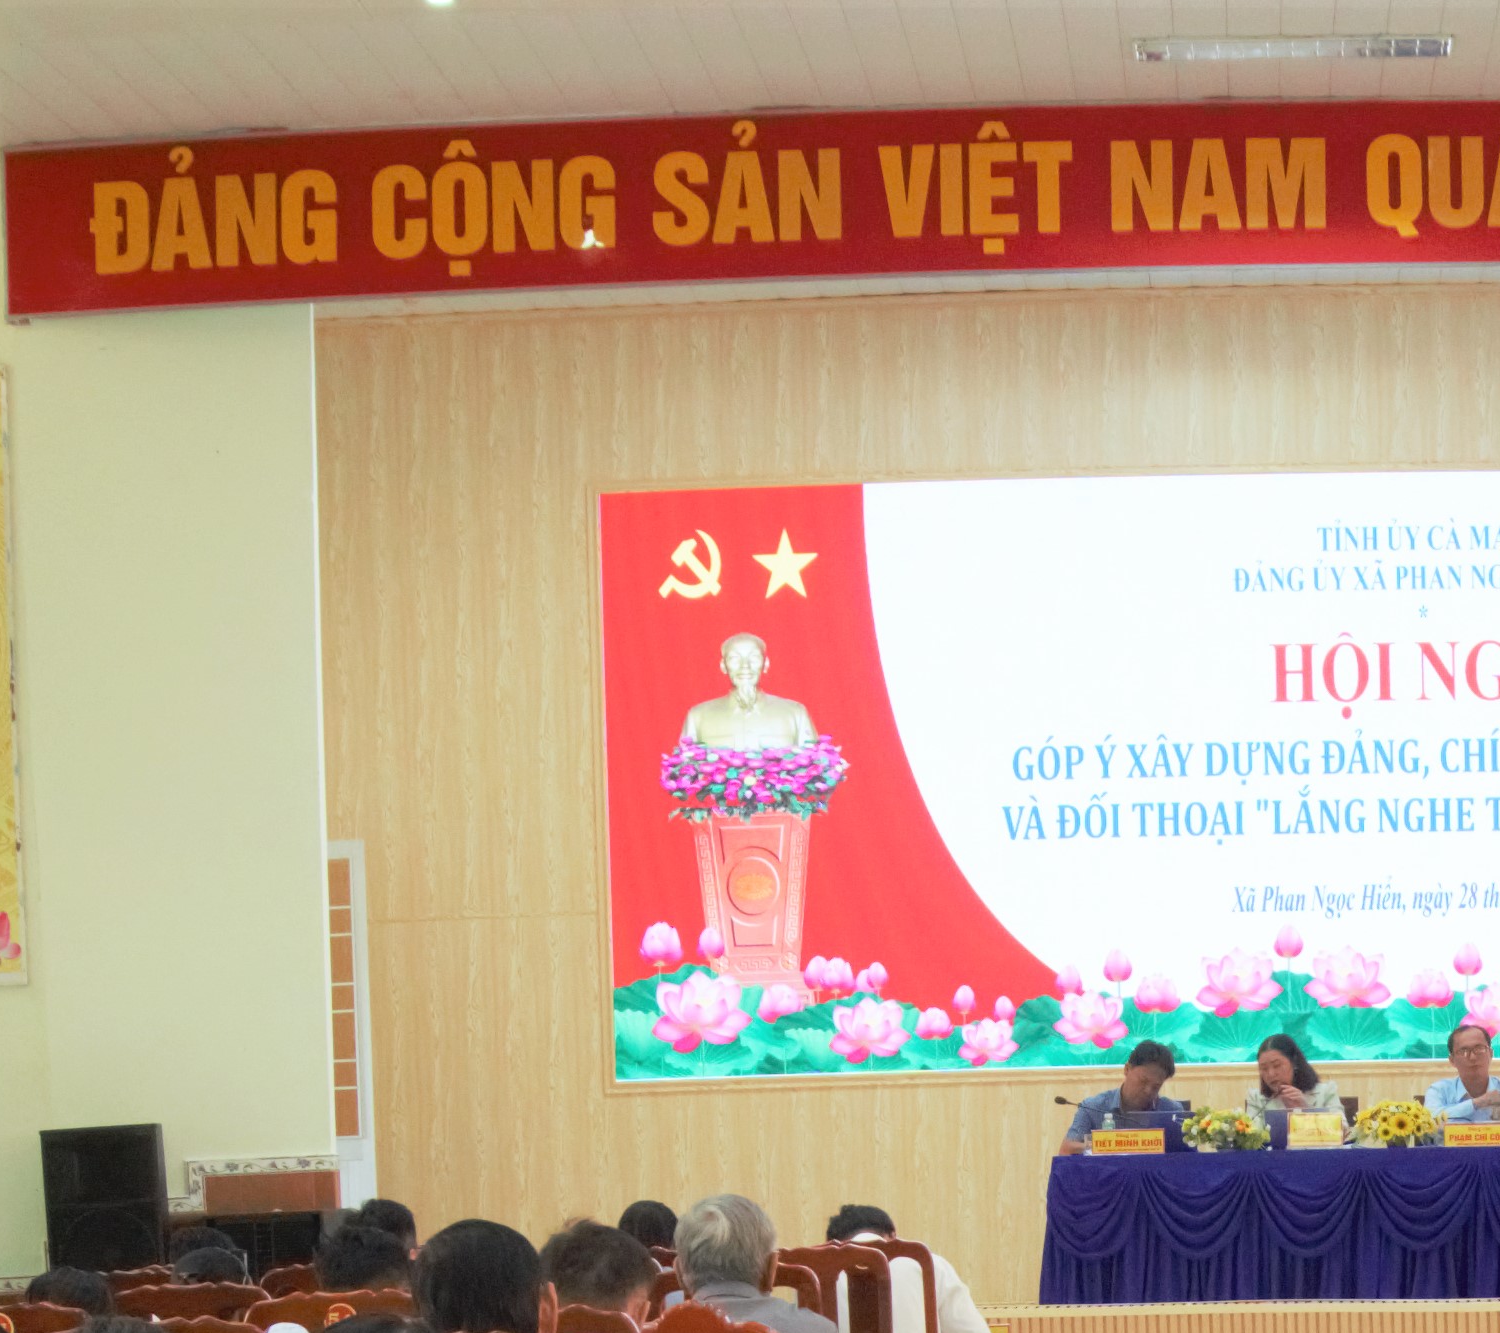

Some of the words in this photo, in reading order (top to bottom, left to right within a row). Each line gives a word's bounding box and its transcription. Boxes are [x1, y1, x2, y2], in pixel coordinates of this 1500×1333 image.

[90, 147, 337, 275] ĐẢNG
[372, 140, 616, 276] CỘNG
[653, 120, 842, 246] SẢN
[878, 121, 1072, 255] VIỆT
[1111, 138, 1326, 233] NAM
[1273, 632, 1394, 719] HỘI
[1012, 736, 1084, 781] GÓP
[1095, 734, 1116, 779] Ý
[1126, 734, 1194, 778] XÂY
[1204, 740, 1310, 785] DỰNG
[1321, 729, 1429, 779] ĐẢNG,
[1001, 795, 1046, 840] VÀ
[1056, 791, 1120, 839] ĐỐI
[1132, 800, 1244, 845] THOẠI
[1377, 797, 1475, 832] NGHE
